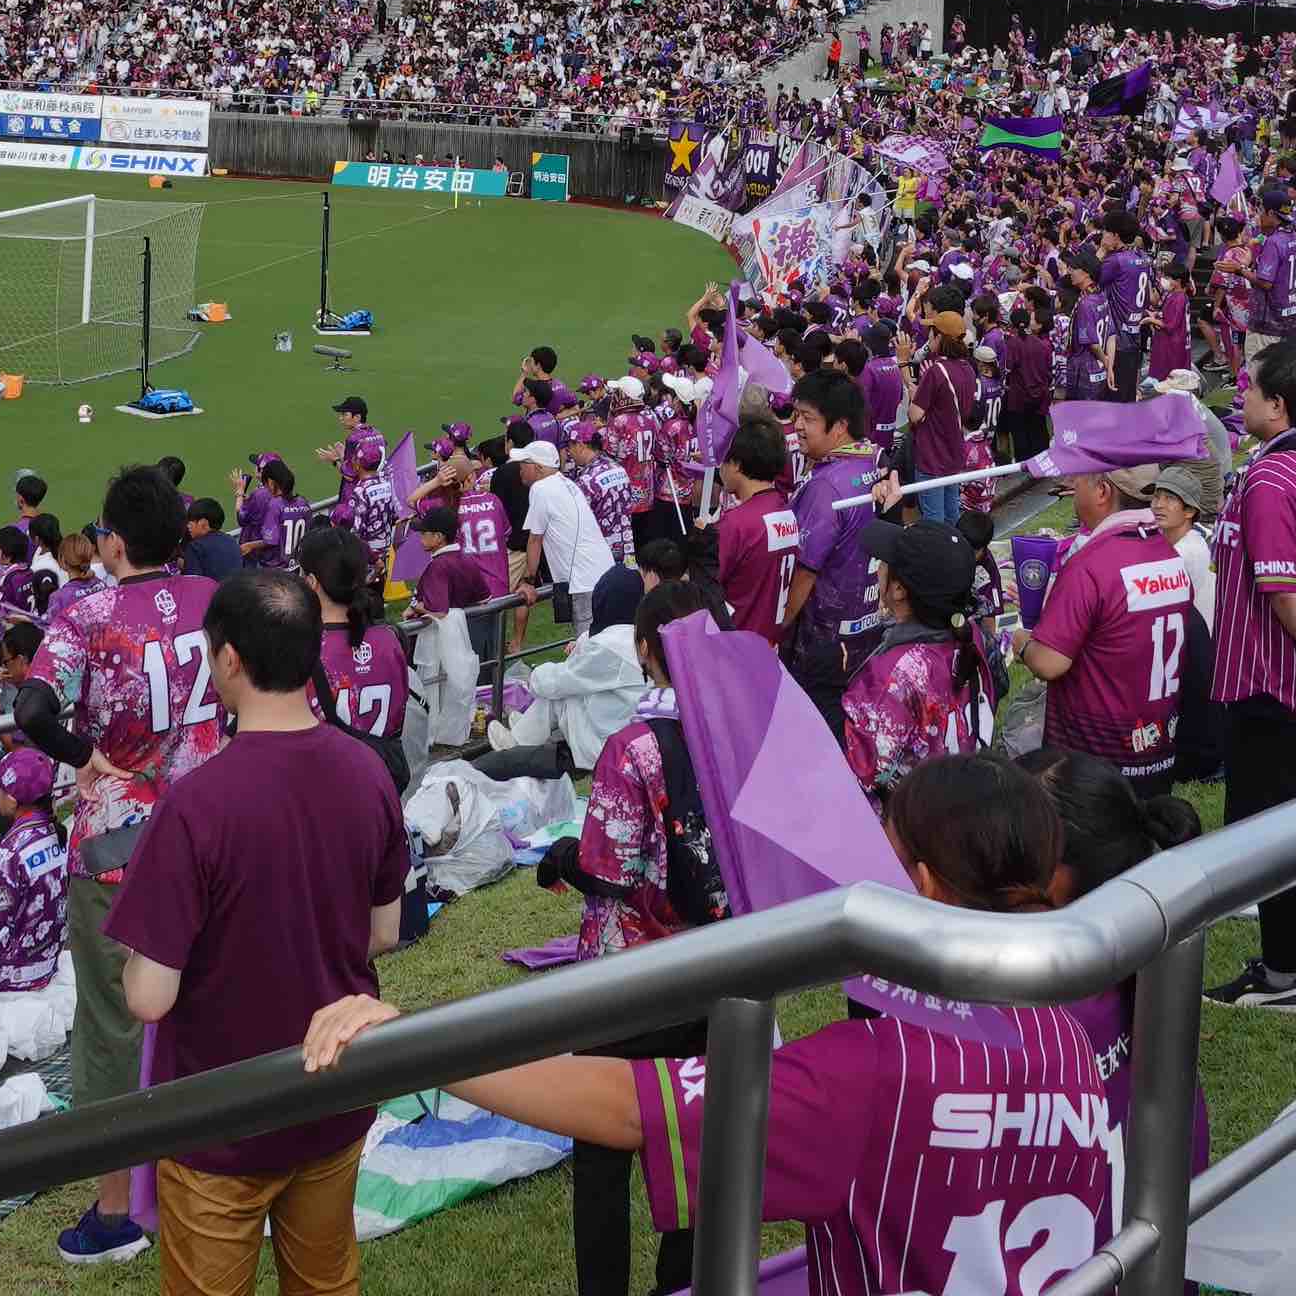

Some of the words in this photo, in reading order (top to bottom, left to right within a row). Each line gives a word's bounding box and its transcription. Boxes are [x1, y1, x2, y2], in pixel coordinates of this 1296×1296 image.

[109, 153, 199, 173] SHINX
[533, 170, 567, 185] 明治安田
[368, 165, 475, 193] 明治安田
[1136, 271, 1148, 308] 8
[457, 501, 496, 515] SHINX
[461, 519, 499, 554] 12
[1253, 560, 1296, 576] SHINX
[1134, 570, 1189, 598] Yakult
[1147, 612, 1184, 703] 12
[142, 628, 217, 733] 12
[929, 1092, 1111, 1150] SHINX
[941, 1192, 1096, 1296] 12
